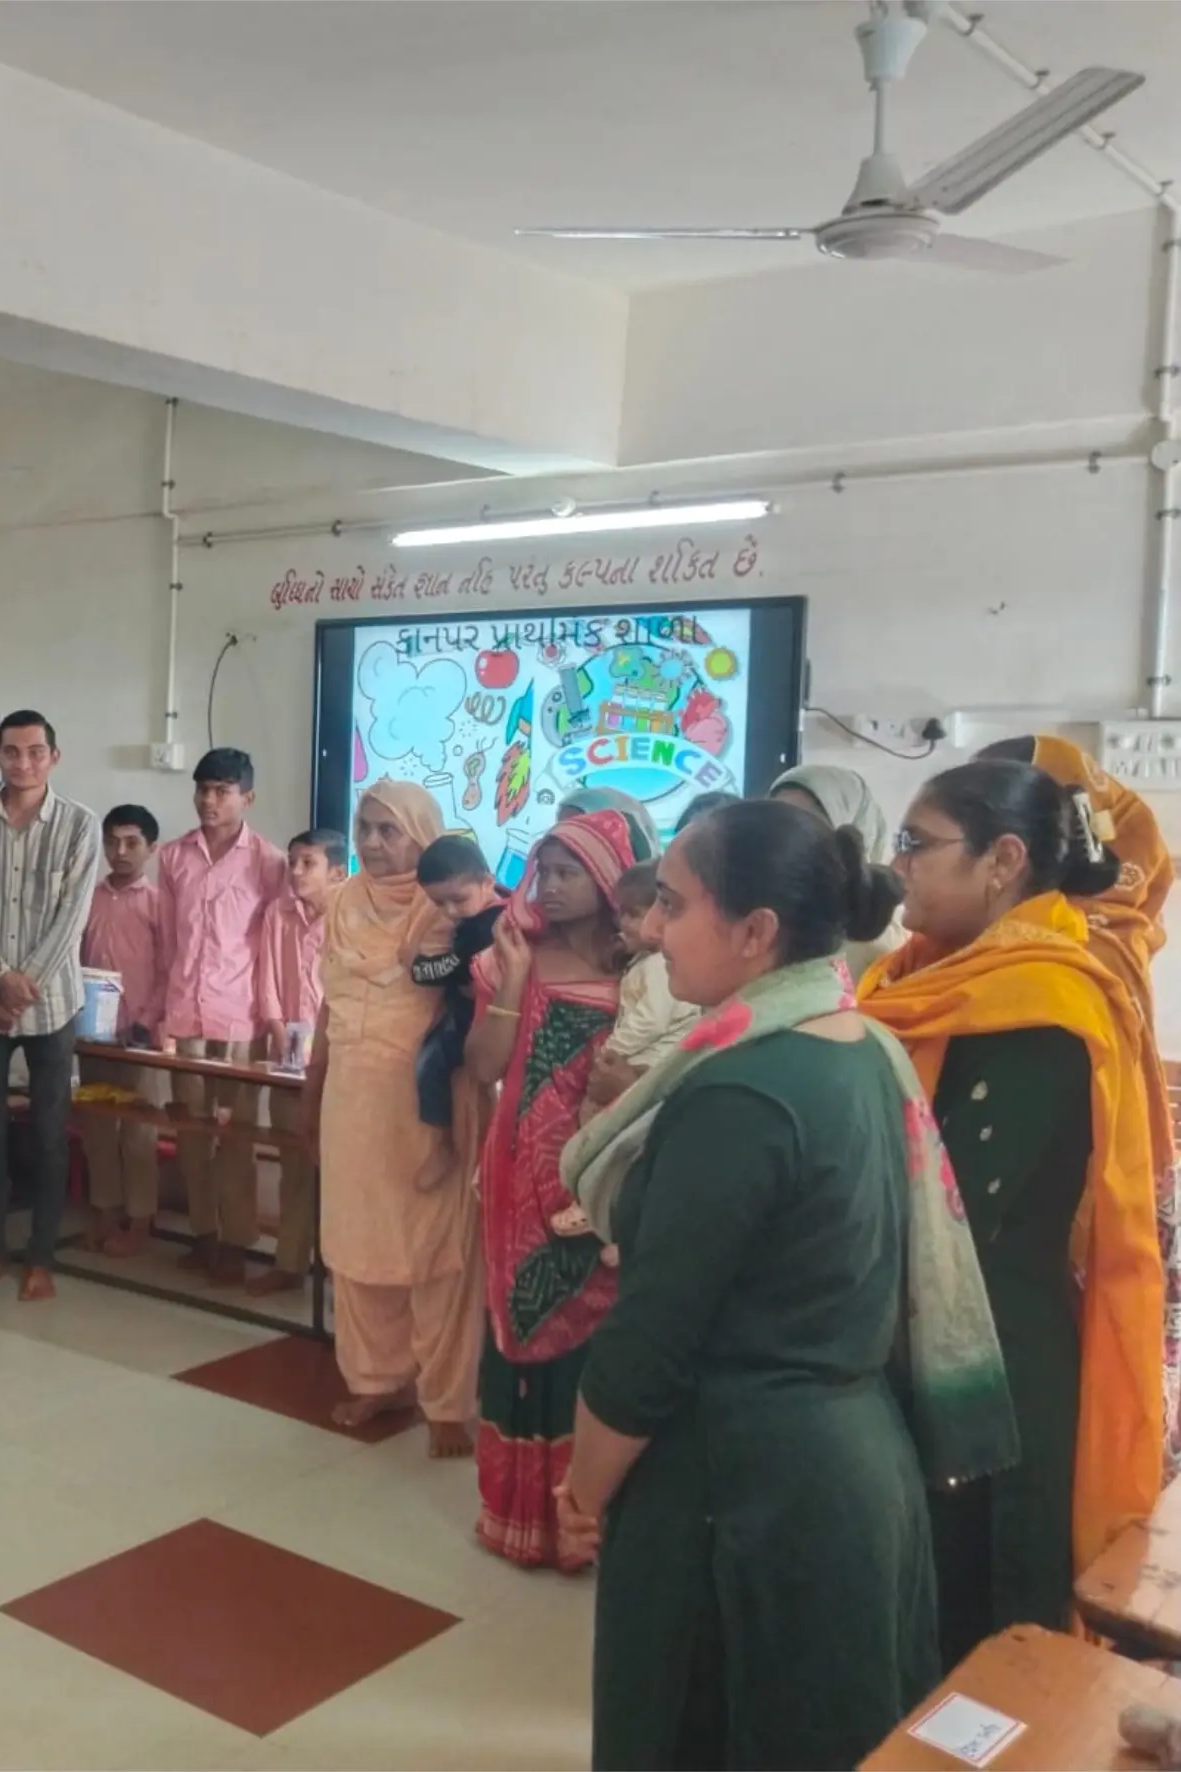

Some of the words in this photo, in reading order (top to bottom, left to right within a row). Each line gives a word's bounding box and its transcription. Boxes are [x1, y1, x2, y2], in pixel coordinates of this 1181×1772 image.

[558, 556, 640, 590] કલ્પના
[614, 614, 704, 646] શાળા
[558, 736, 723, 788] SCIENCE
